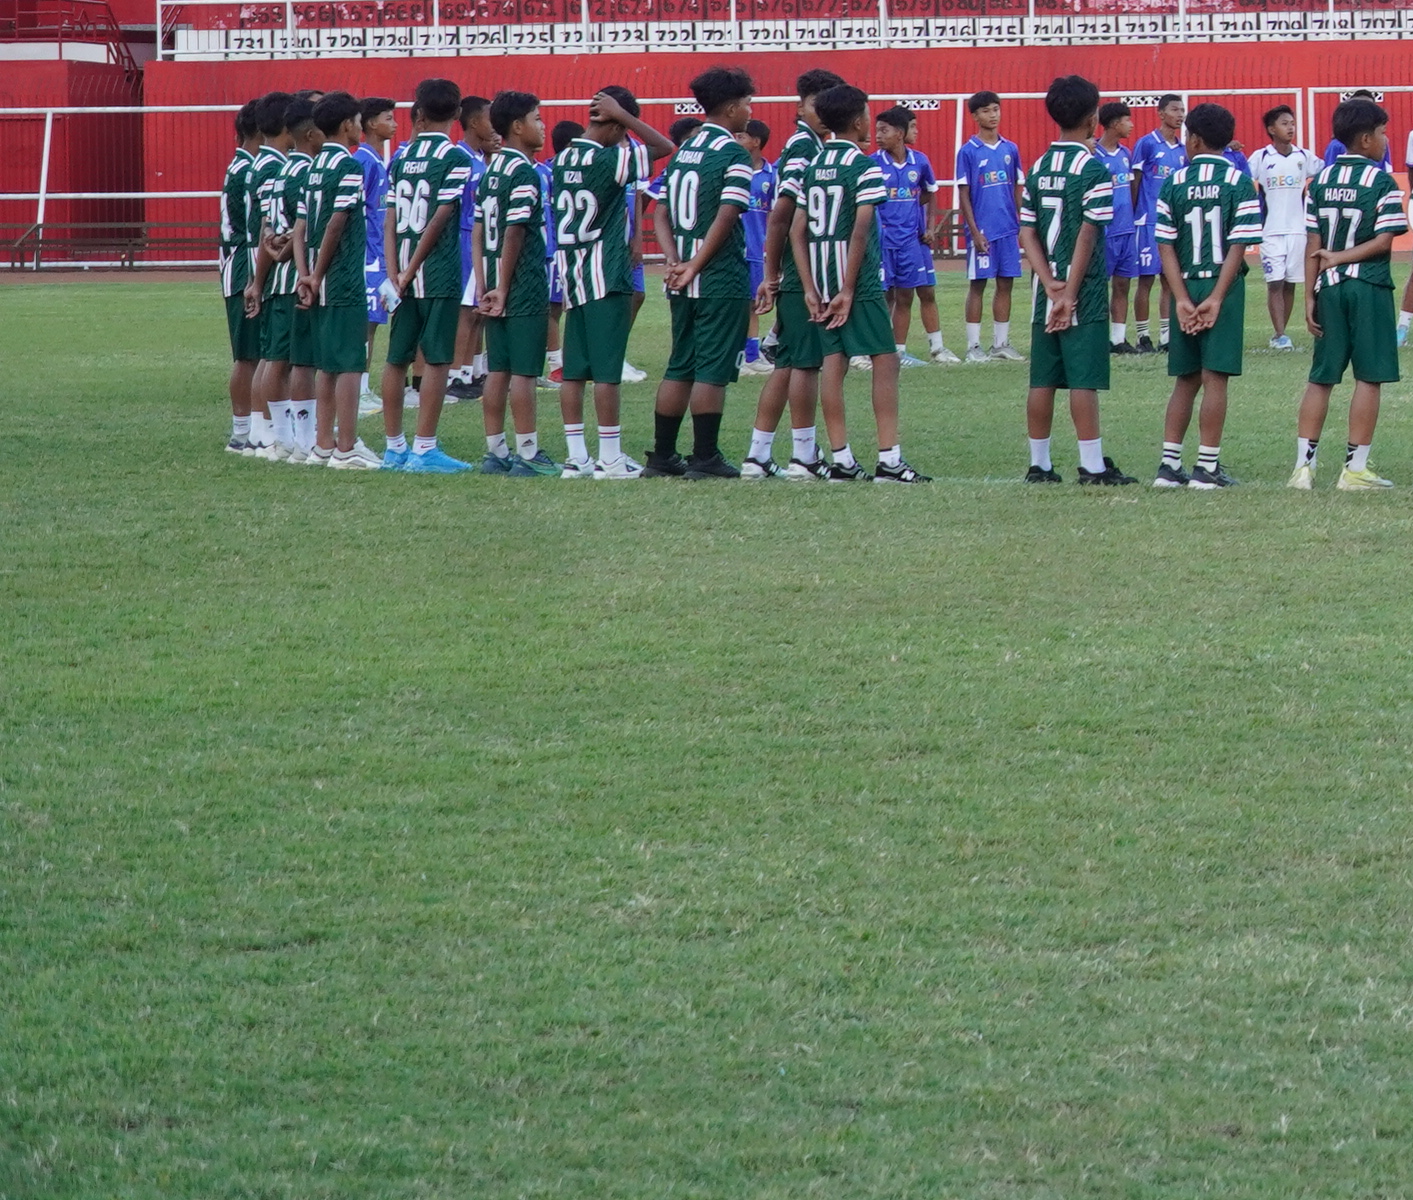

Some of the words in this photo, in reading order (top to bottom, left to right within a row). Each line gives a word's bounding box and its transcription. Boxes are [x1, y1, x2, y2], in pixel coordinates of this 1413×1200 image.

[395, 178, 430, 235] 66
[557, 189, 602, 245] 22
[667, 168, 700, 231] 10
[807, 184, 845, 237] 97
[1187, 185, 1221, 200] FAJAR
[1324, 187, 1358, 202] HAFIZH
[1041, 196, 1064, 252] 7
[1184, 205, 1224, 266] 11
[1318, 206, 1363, 252] 77
